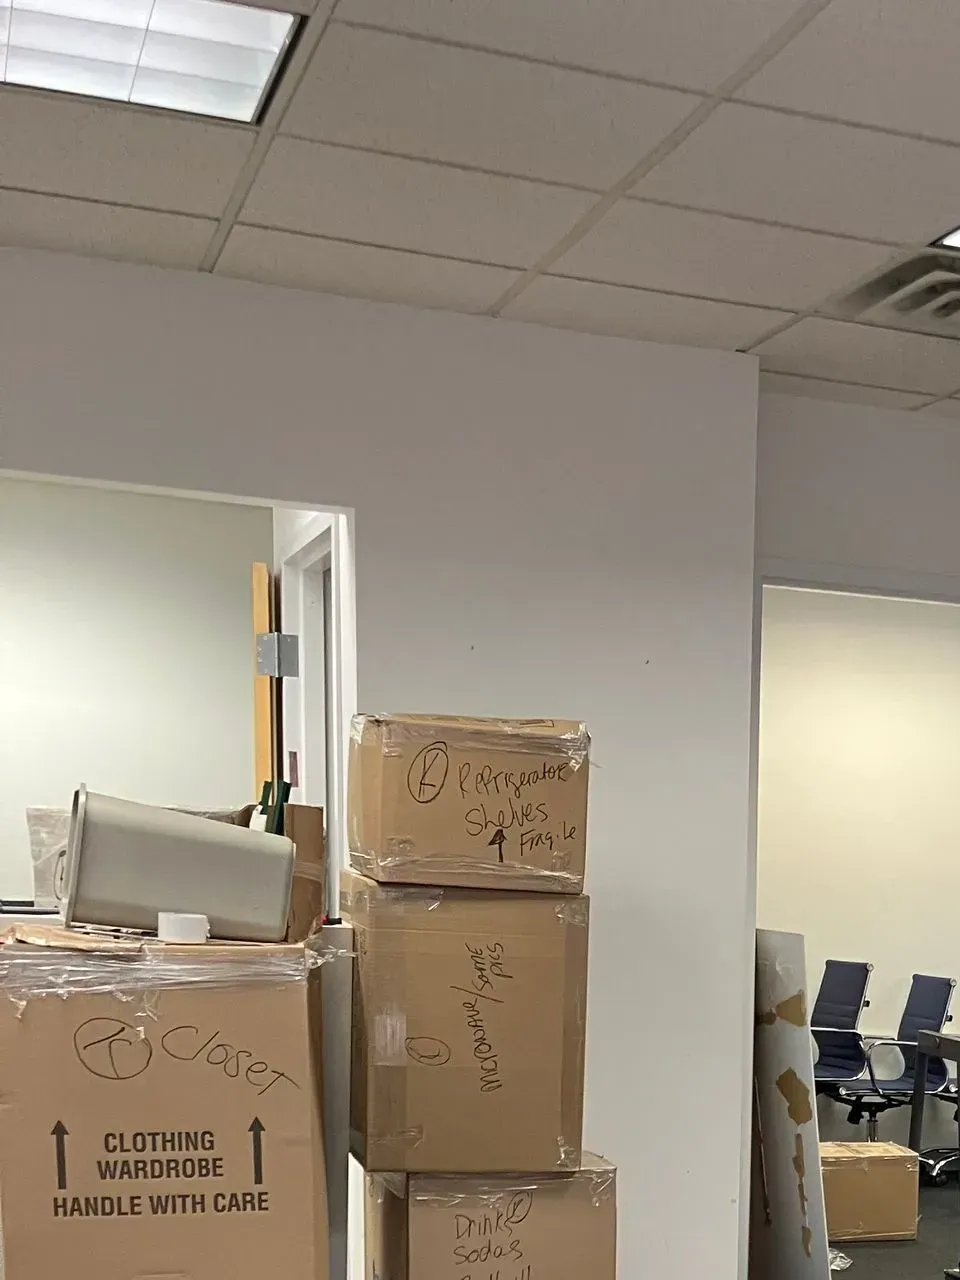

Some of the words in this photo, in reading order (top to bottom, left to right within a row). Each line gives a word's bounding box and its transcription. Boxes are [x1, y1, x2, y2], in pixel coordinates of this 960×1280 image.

[103, 1130, 216, 1154] CLOTHING
[96, 1157, 225, 1181] WARDROBE
[53, 1195, 143, 1218] HANDLE
[149, 1193, 206, 1216] WITH
[213, 1191, 270, 1214] CARE
